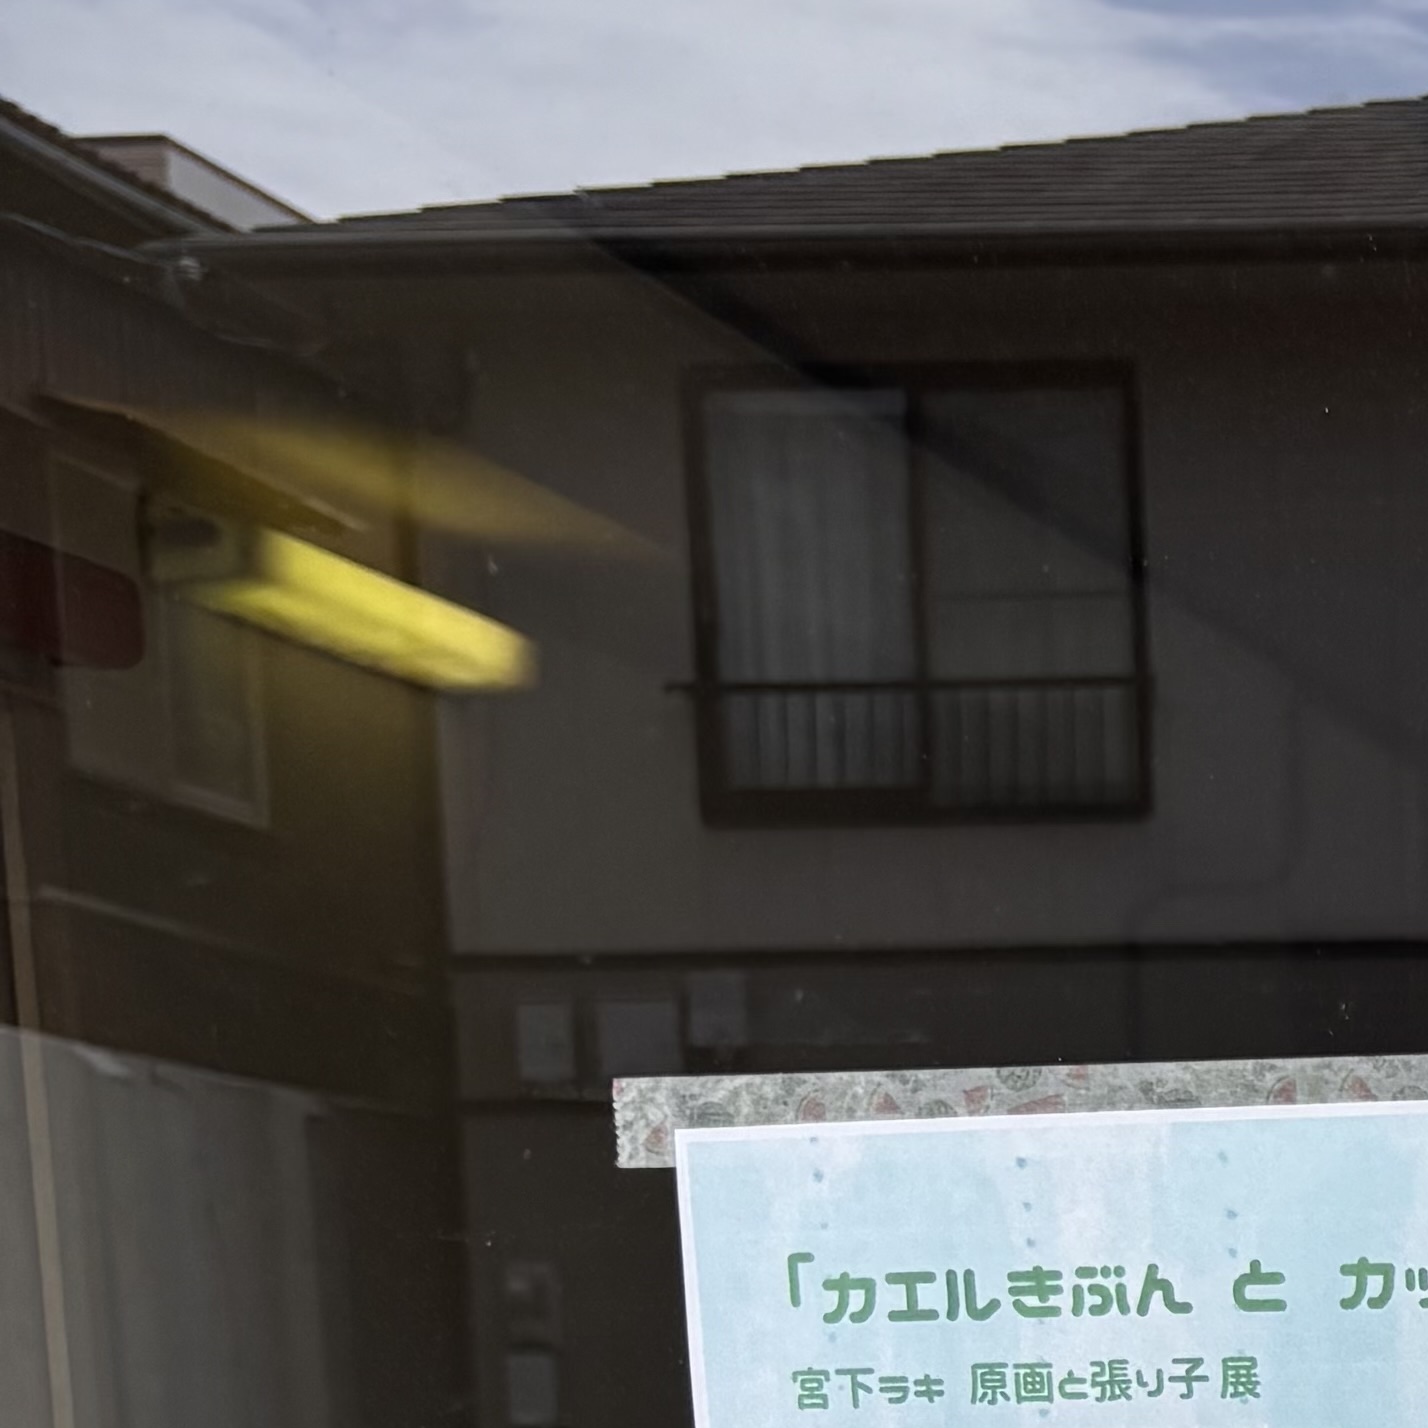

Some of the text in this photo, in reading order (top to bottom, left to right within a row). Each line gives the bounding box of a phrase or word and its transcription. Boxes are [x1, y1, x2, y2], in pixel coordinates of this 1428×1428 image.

[787, 1252, 1194, 1325] 「カエルきぶん
[1232, 1259, 1288, 1313] と
[791, 1355, 1261, 1411] 宮下ラキ 原画と張り子展
